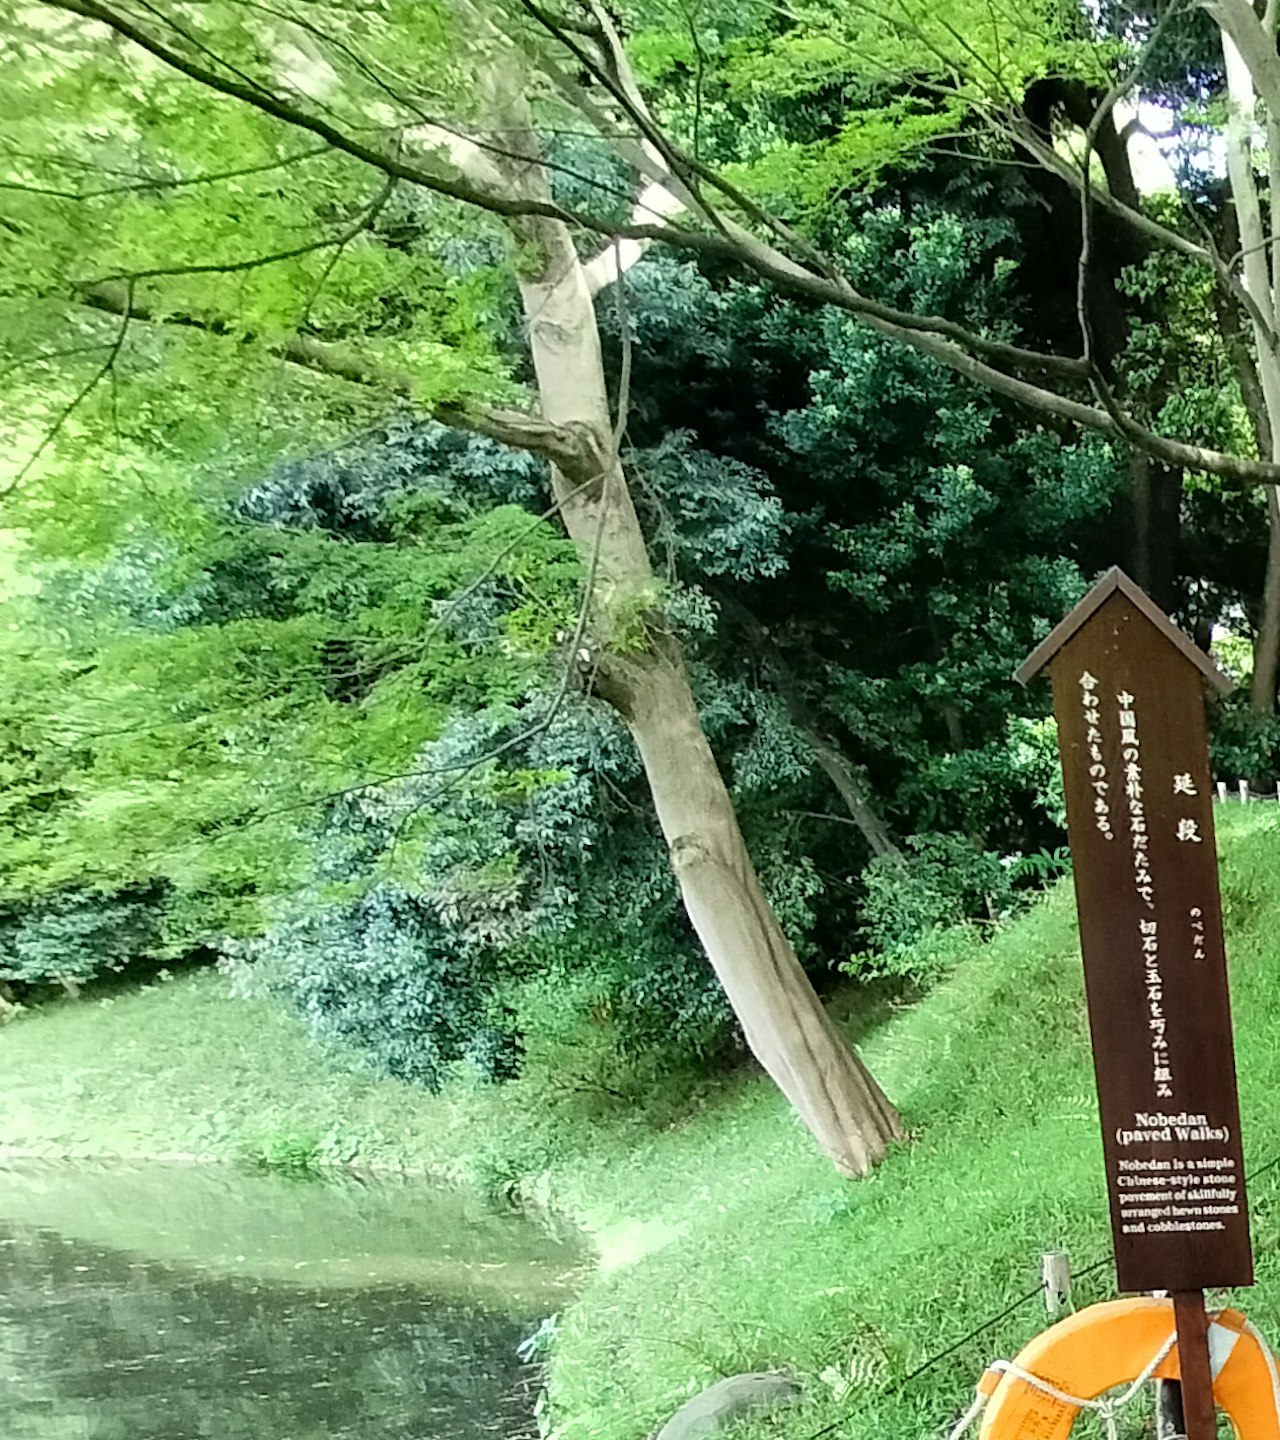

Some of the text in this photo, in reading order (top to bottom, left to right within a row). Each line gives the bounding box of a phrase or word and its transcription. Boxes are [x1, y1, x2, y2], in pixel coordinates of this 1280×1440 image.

[1078, 670, 1115, 842] 合わせたものである。
[1190, 907, 1206, 959] のべだん
[1135, 1112, 1208, 1126] Nobedan
[1115, 1126, 1229, 1145] (paved Walks)
[1118, 1157, 1235, 1171] Nobedan is a simple
[1117, 1173, 1236, 1187] Chinese-style stone
[1118, 1188, 1237, 1204] pavement of skillfully
[1120, 1205, 1239, 1219] arranged hewn stones
[1122, 1220, 1226, 1233] and cobblestones.
